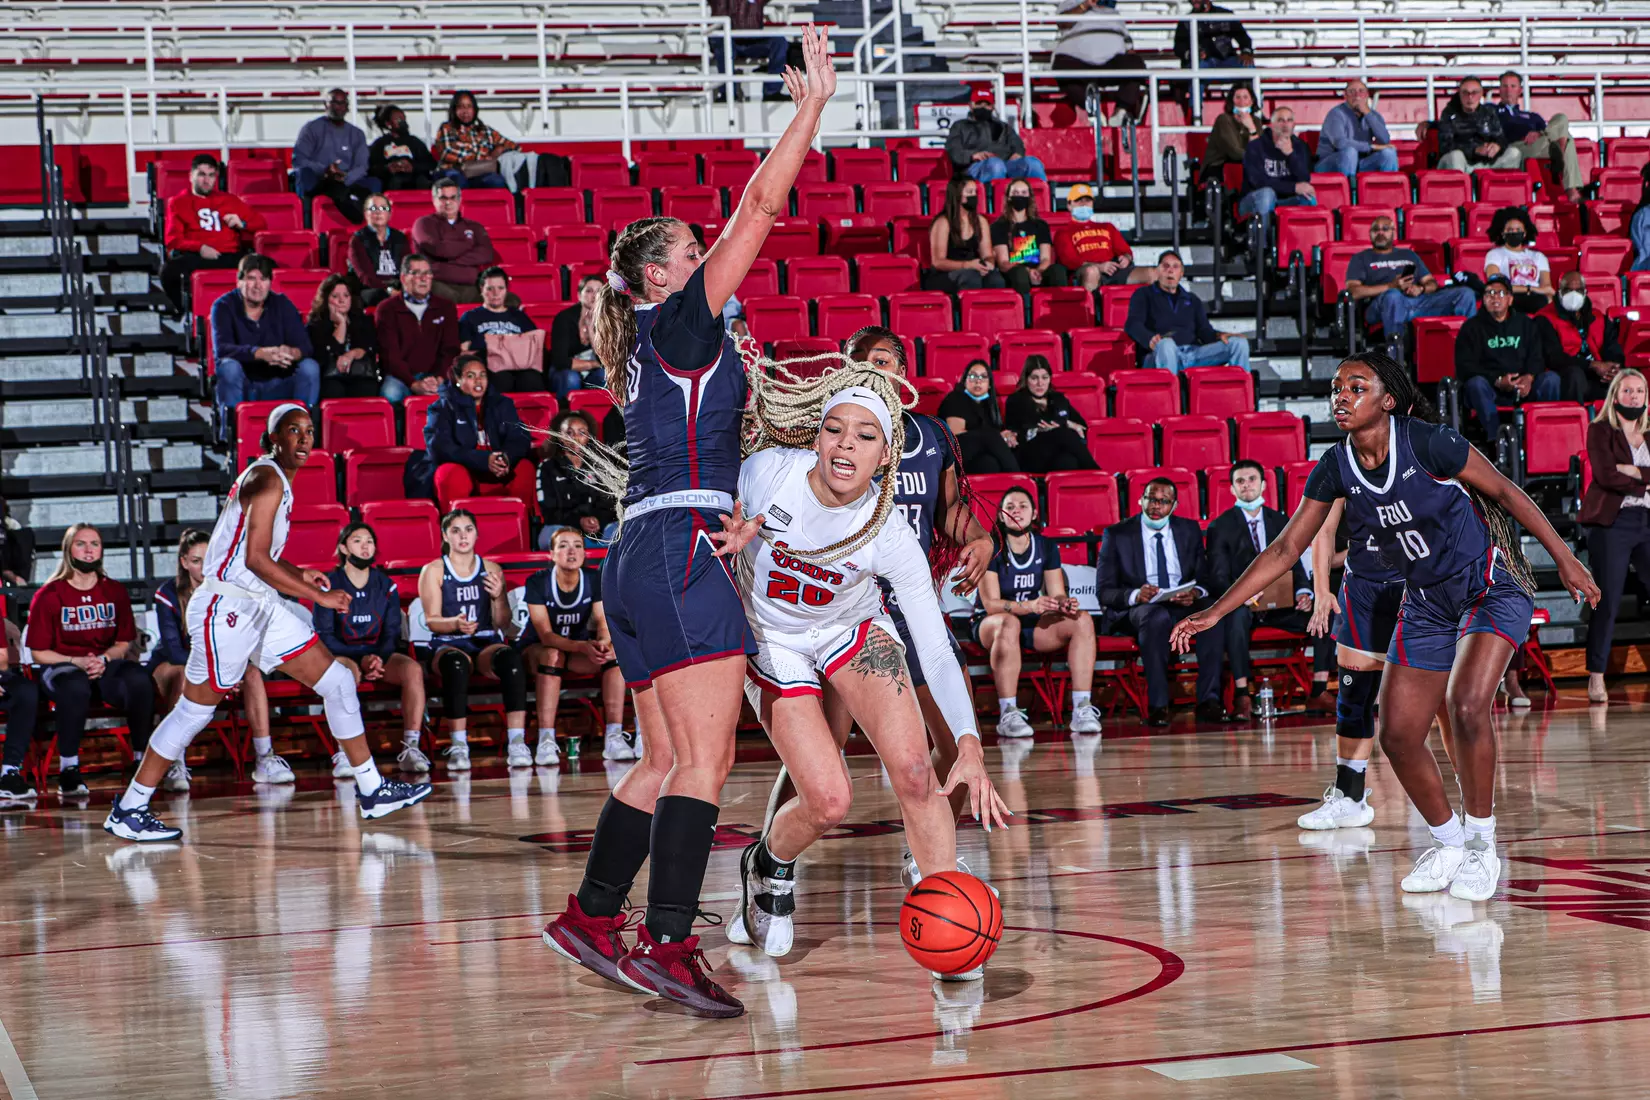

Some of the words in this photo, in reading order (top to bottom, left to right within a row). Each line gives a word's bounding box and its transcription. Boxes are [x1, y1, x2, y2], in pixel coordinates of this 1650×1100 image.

[1487, 335, 1521, 350] ebay
[1402, 466, 1416, 480] NEC
[894, 472, 927, 495] FDU
[661, 493, 721, 505] UNDER
[1376, 500, 1413, 528] FDU
[1396, 530, 1431, 561] 10
[766, 570, 835, 606] 20
[1013, 573, 1035, 589] FDU
[456, 585, 480, 602] FDU
[61, 602, 116, 624] FDU
[352, 614, 372, 623] FDU
[556, 612, 580, 625] FDU
[910, 916, 924, 940] SJ
